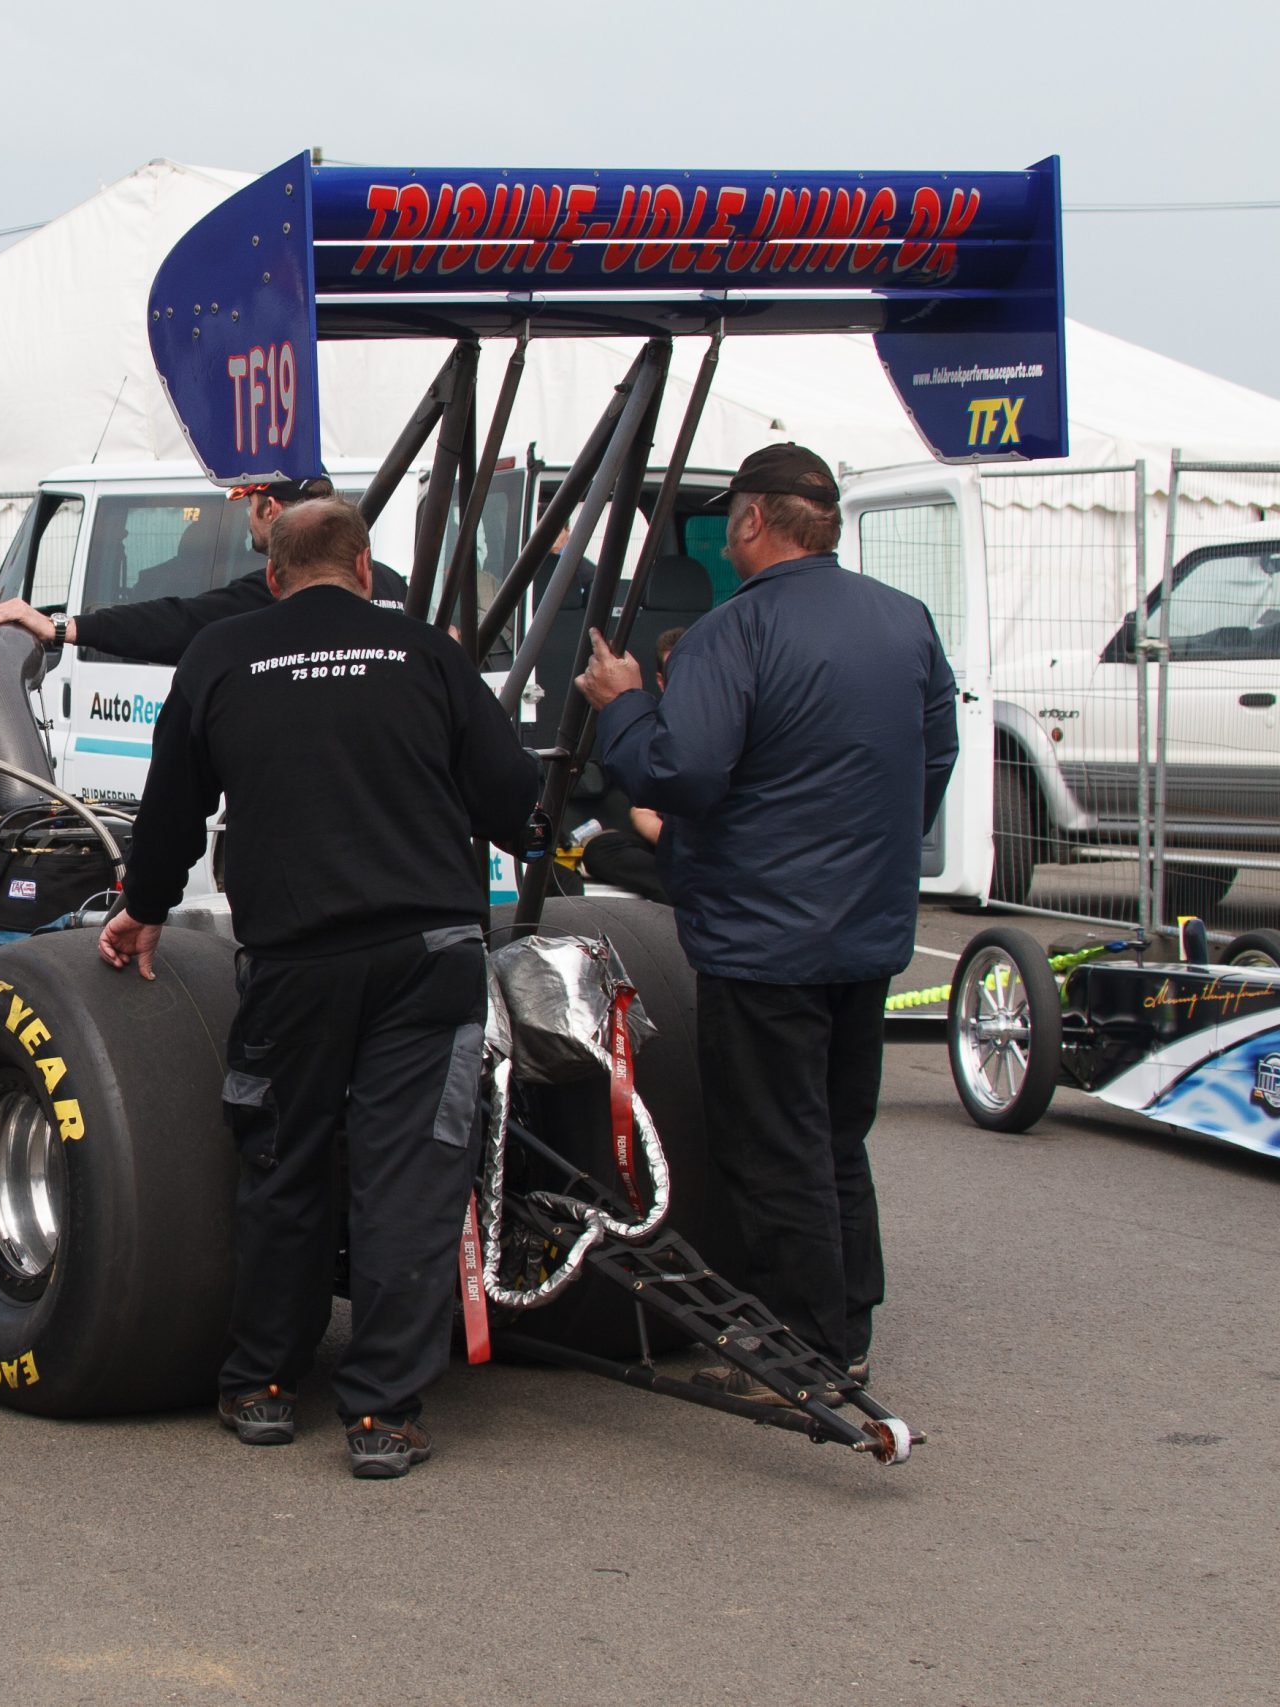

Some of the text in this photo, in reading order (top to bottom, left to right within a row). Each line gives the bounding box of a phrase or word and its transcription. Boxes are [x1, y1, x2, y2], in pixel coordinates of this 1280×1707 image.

[351, 184, 982, 281] TRIBUNE-UDLEJNING.DK
[912, 362, 1044, 388] www.Holbrookperformanceparts.com
[228, 340, 297, 457] TF19
[967, 397, 1025, 446] TFX
[250, 649, 407, 674] TRIBUNE-UDLEJNING.DK
[292, 664, 366, 681] 75 80 01 02
[618, 1135, 628, 1166] REMOVE
[464, 1241, 477, 1270] BEFORE
[467, 1276, 480, 1302] FLIGHT
